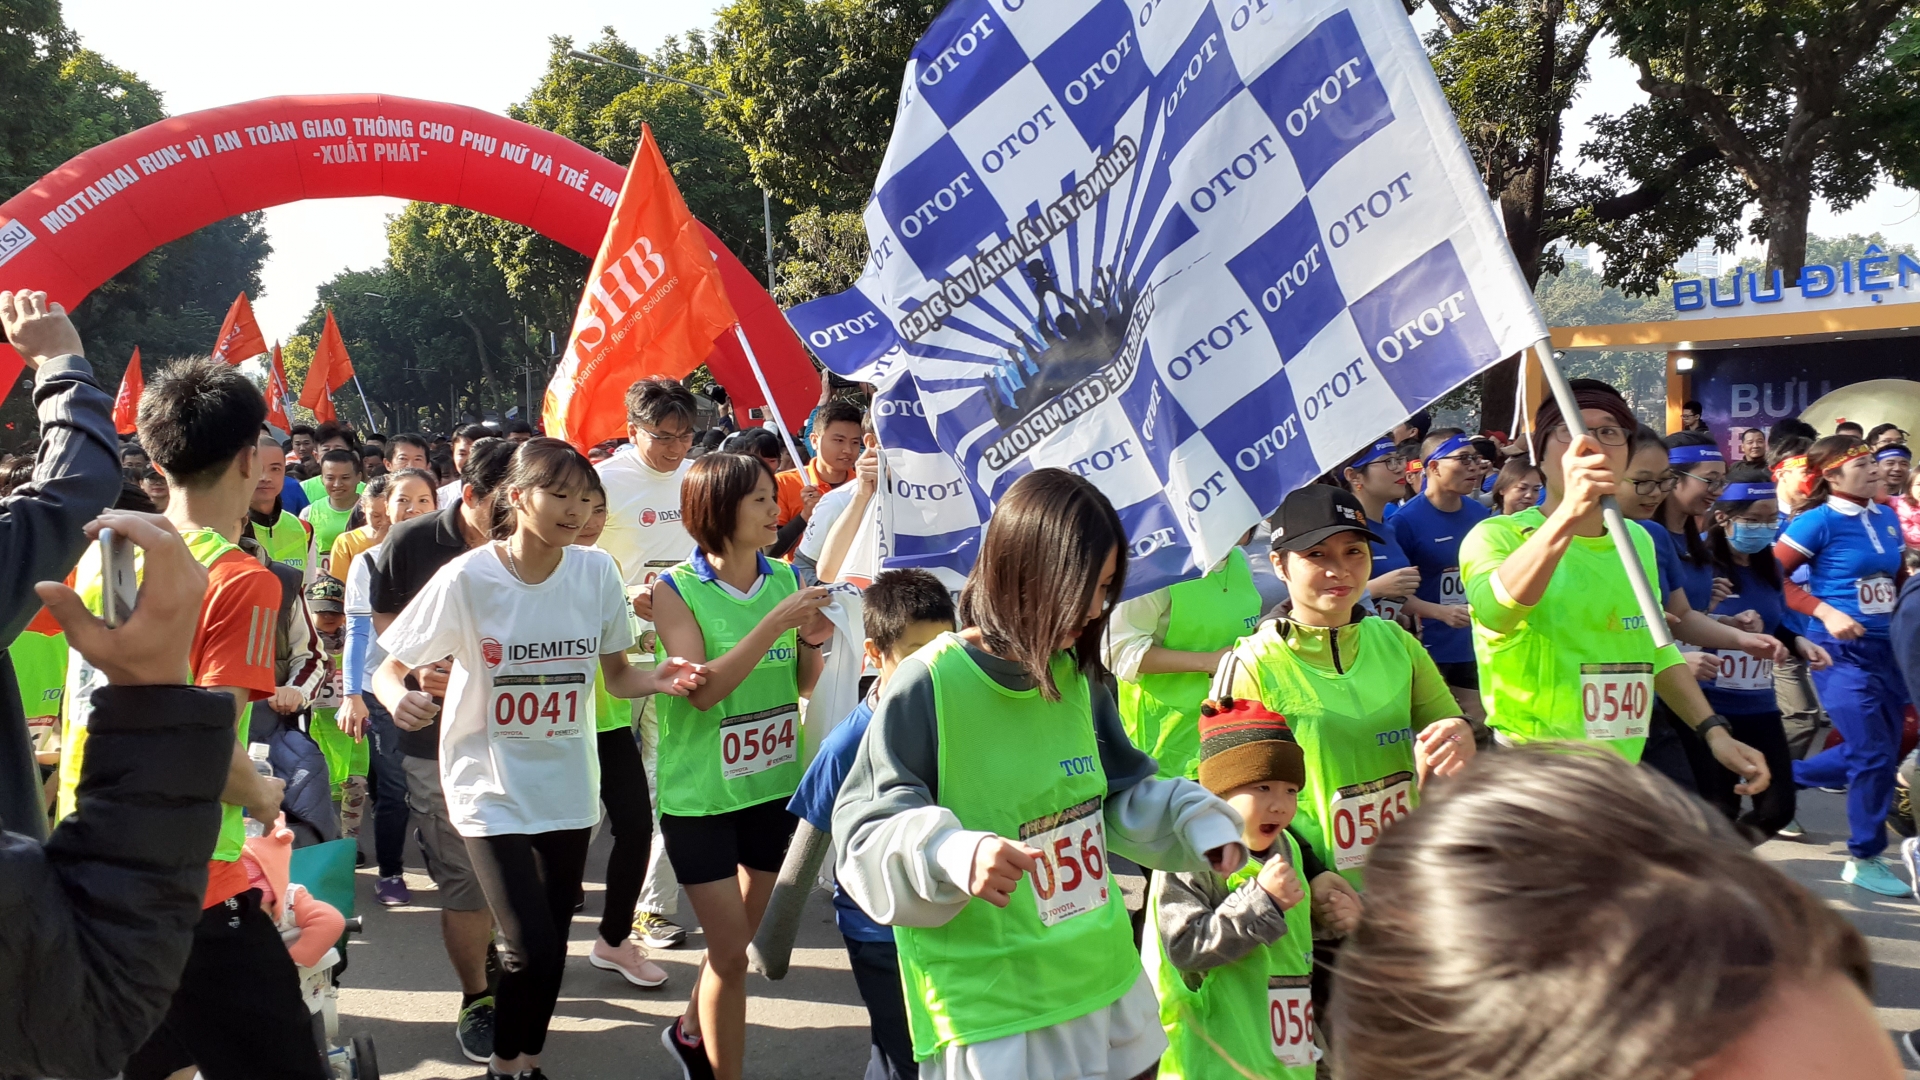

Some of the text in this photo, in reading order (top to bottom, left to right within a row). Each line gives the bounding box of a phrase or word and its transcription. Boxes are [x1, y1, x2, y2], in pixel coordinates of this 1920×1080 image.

[313, 136, 428, 164] -XUẤT PHÁT-
[39, 115, 619, 234] MOTTAINAI RUN: VÌ AN TOÀN GIAO THÔNG CHO PHỤ NỮ VÀ TRẺ EM
[578, 235, 667, 353] SHB
[1672, 266, 1784, 311] BƯU
[576, 344, 615, 389] partners,
[611, 310, 643, 346] flexible
[642, 275, 680, 315] solutions
[508, 637, 597, 661] IDEMITSU
[495, 689, 578, 726] 0041
[1581, 681, 1649, 723] 0540
[722, 718, 795, 765] 0564
[1048, 902, 1076, 918] TOYOTA
